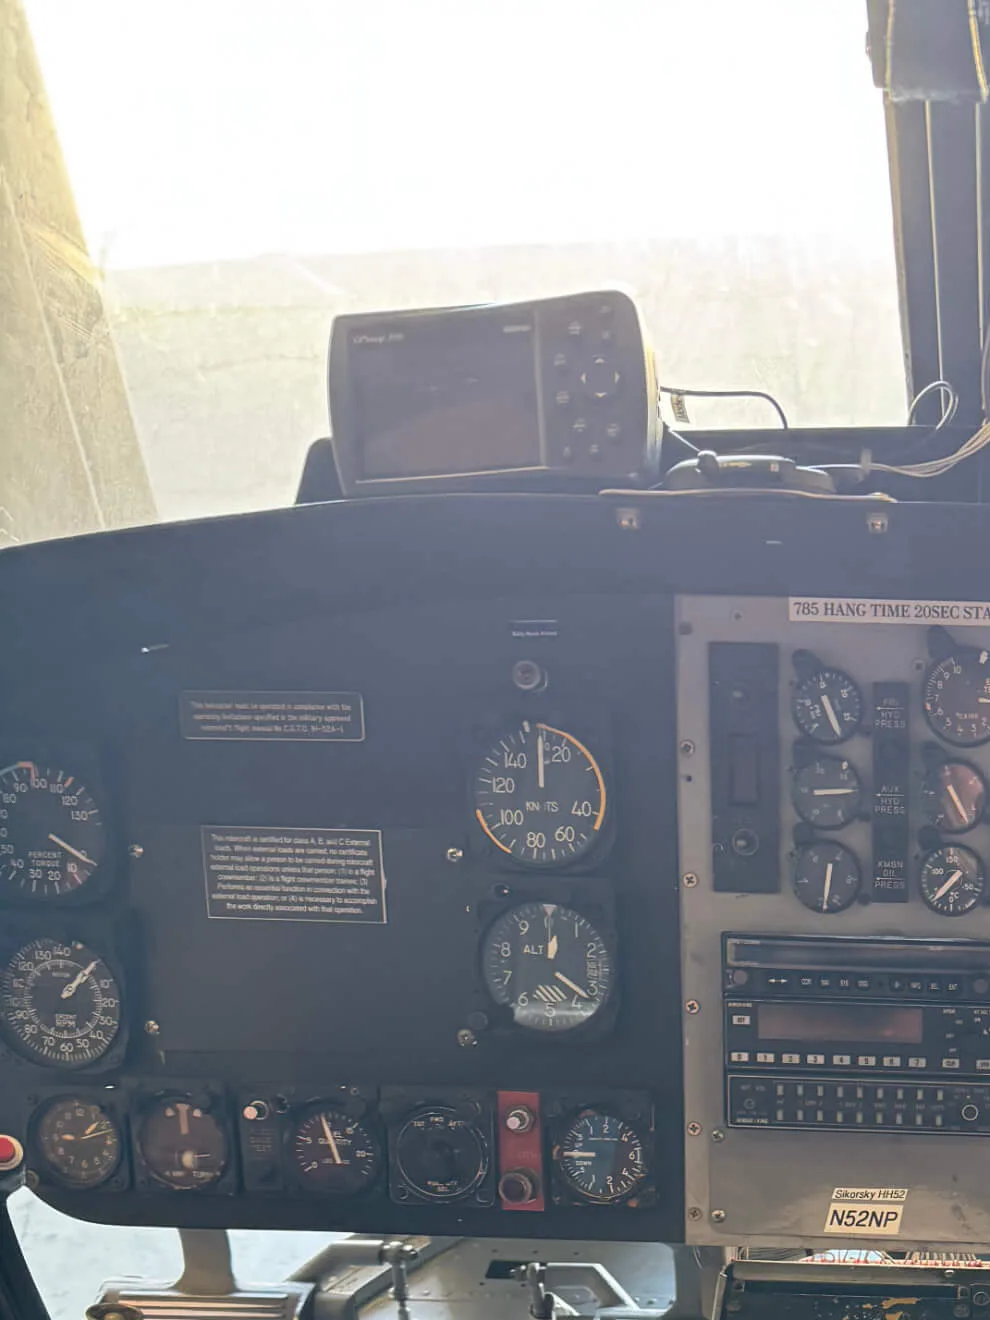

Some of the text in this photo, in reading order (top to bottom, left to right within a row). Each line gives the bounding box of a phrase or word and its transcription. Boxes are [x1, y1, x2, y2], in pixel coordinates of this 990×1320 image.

[793, 602, 819, 616] 785
[822, 603, 866, 617] HANG
[870, 604, 910, 618] TIME
[914, 605, 960, 620] 20SEC
[875, 720, 906, 728] PRESS
[504, 752, 527, 769] 140
[552, 747, 571, 763] 20
[492, 777, 515, 793] 120
[61, 796, 79, 806] 120
[526, 801, 559, 813] KNTS
[71, 810, 89, 820] 130
[571, 801, 592, 817] 40
[875, 806, 905, 814] PRESS
[500, 809, 524, 825] 100
[526, 832, 545, 848] 80
[555, 826, 575, 842] 60
[29, 868, 43, 879] 30
[48, 870, 62, 881] 20
[518, 920, 530, 936] 9
[574, 921, 579, 939] 1
[500, 941, 512, 958] 8
[523, 944, 544, 956] ALT
[586, 942, 597, 959] 2
[503, 970, 513, 985] 7
[586, 983, 599, 996] 3
[518, 992, 529, 1007] 6
[544, 1003, 557, 1018] 5
[41, 1036, 55, 1047] 70
[60, 1042, 74, 1053] 60
[76, 1039, 90, 1049] 50
[835, 1190, 905, 1200] Sikorsky HH52
[829, 1209, 898, 1228] N52NP
